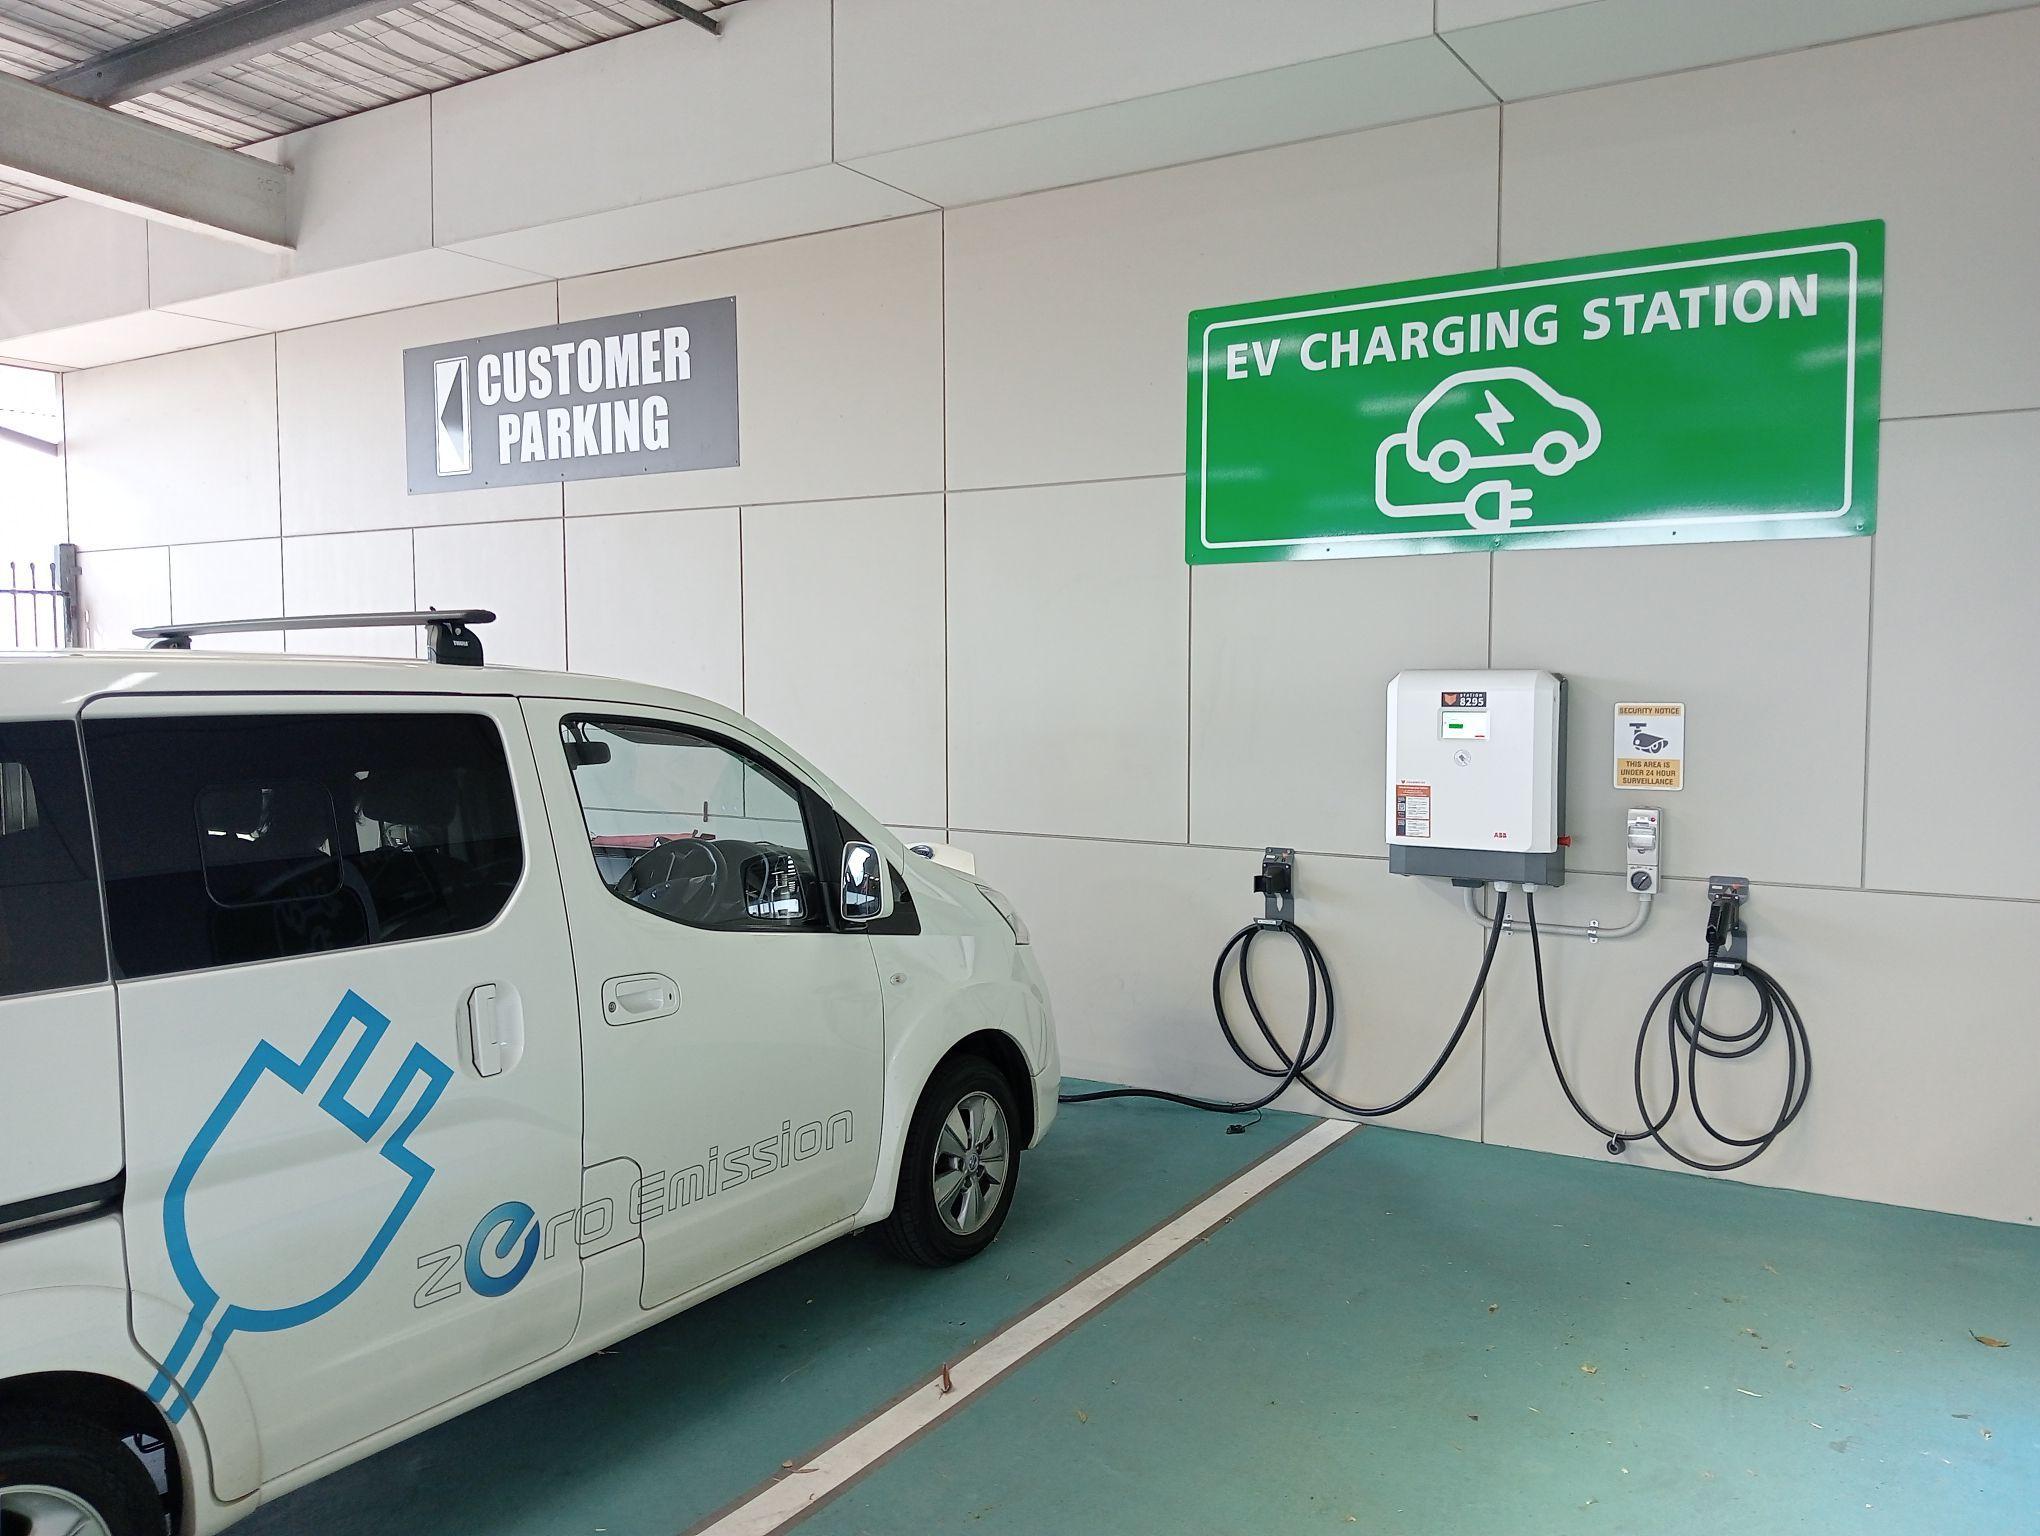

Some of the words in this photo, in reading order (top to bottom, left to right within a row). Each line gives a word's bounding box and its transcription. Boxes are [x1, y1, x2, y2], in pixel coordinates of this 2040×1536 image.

[1227, 338, 1280, 381] EV
[1300, 303, 1558, 372] CHARGING
[1582, 273, 1818, 341] STATION
[477, 326, 691, 406] CUSTOMER
[498, 395, 669, 465] PARKING
[1460, 697, 1484, 706] 8295
[1619, 707, 1653, 715] SECURITY
[1654, 707, 1680, 715] NOTICE
[1626, 760, 1642, 768] THIS
[1656, 769, 1676, 777] HOUR
[1622, 777, 1674, 785] SURVEILLANCE
[413, 1197, 614, 1309] zero
[629, 1109, 854, 1225] Emission
